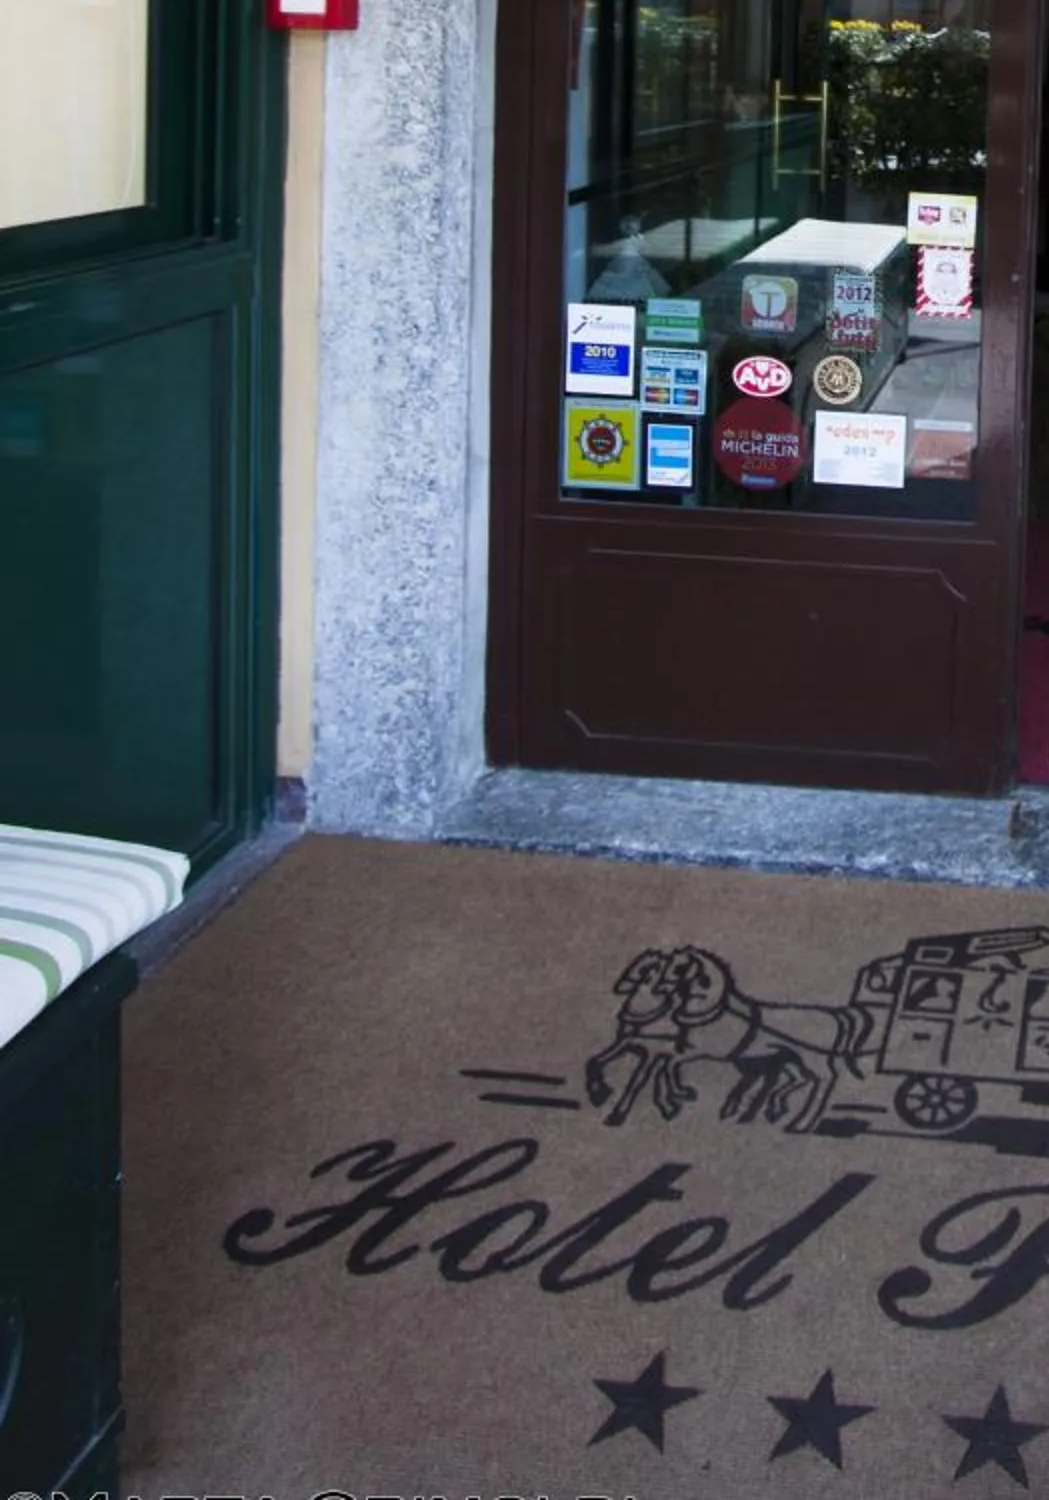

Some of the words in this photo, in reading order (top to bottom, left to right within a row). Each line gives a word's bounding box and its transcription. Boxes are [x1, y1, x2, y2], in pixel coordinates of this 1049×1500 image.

[836, 285, 871, 301] 2012
[584, 345, 616, 359] 2010
[721, 439, 799, 458] MICHELIN
[223, 1138, 878, 1311] Hotel
